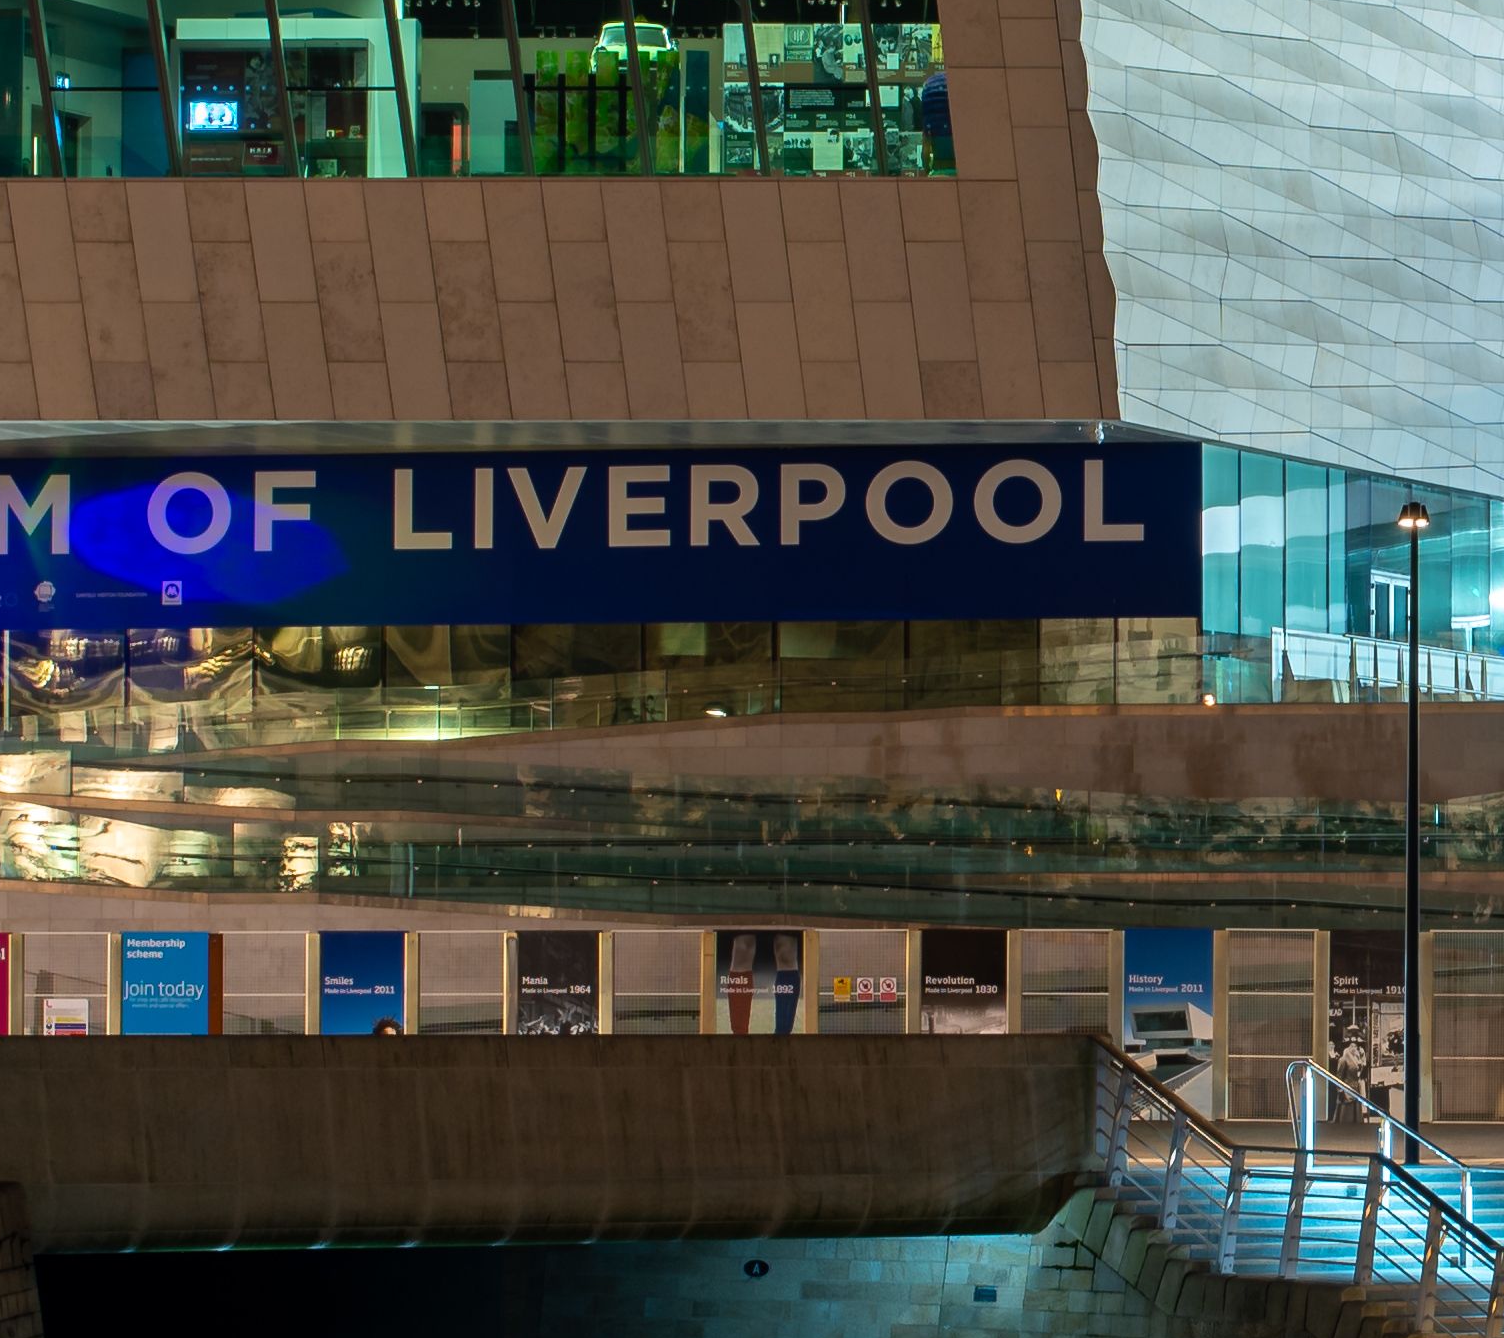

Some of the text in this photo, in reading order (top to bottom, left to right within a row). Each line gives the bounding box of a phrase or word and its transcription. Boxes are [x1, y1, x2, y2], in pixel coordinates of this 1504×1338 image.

[147, 470, 317, 555] OF
[394, 459, 1145, 550] LIVERPOOL
[126, 938, 186, 949] Membership
[126, 949, 164, 959] scheme
[324, 976, 354, 985] Smiles
[522, 976, 548, 985] Mania
[720, 975, 749, 985] Rivals
[925, 975, 975, 985] Revolution
[1128, 974, 1164, 985] History
[1333, 976, 1359, 987] Spirit
[123, 979, 205, 1001] Join today
[374, 985, 395, 994] 2011
[569, 985, 591, 994] 1964
[772, 984, 794, 994] 1892
[975, 985, 998, 994] 1830
[1180, 983, 1204, 993] 2011
